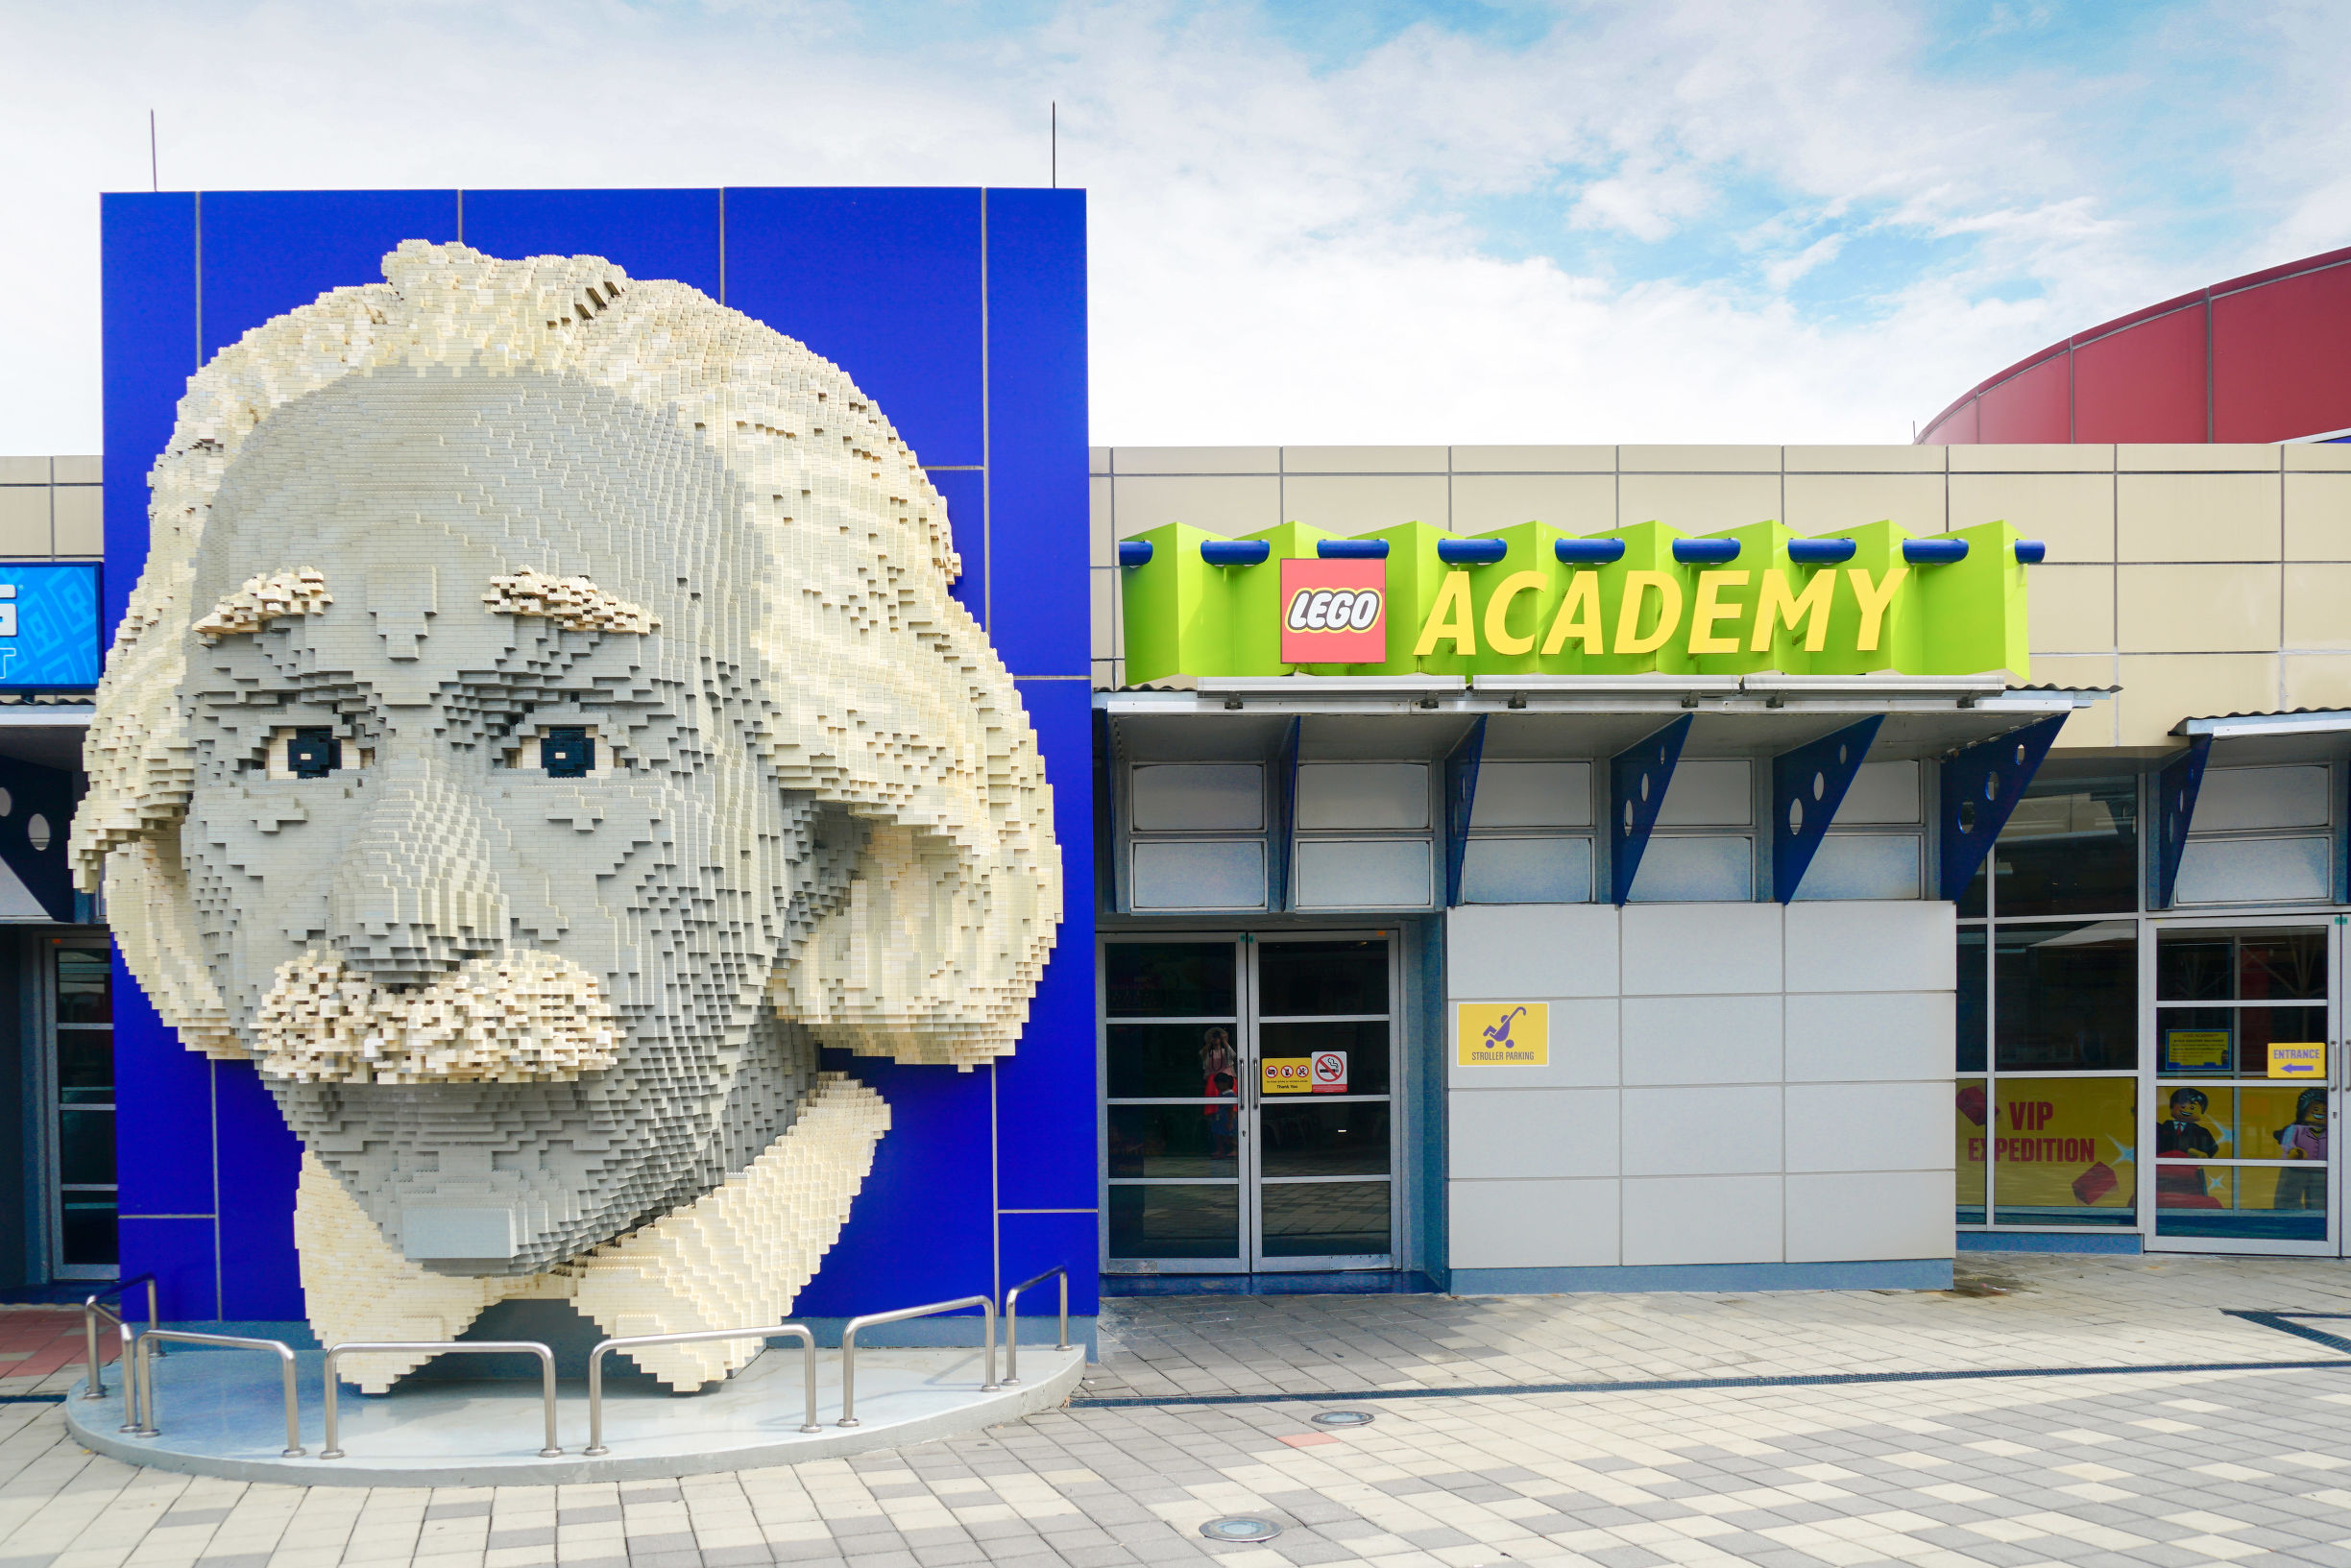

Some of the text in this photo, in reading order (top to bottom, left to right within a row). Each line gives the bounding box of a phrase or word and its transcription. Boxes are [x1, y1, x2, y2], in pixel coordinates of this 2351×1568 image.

[1288, 568, 1910, 656] LEGO ACADEMY
[1471, 1051, 1535, 1061] STROLLER PARKING
[2273, 1049, 2320, 1059] ENTRANCE
[2008, 1101, 2054, 1131] VIP
